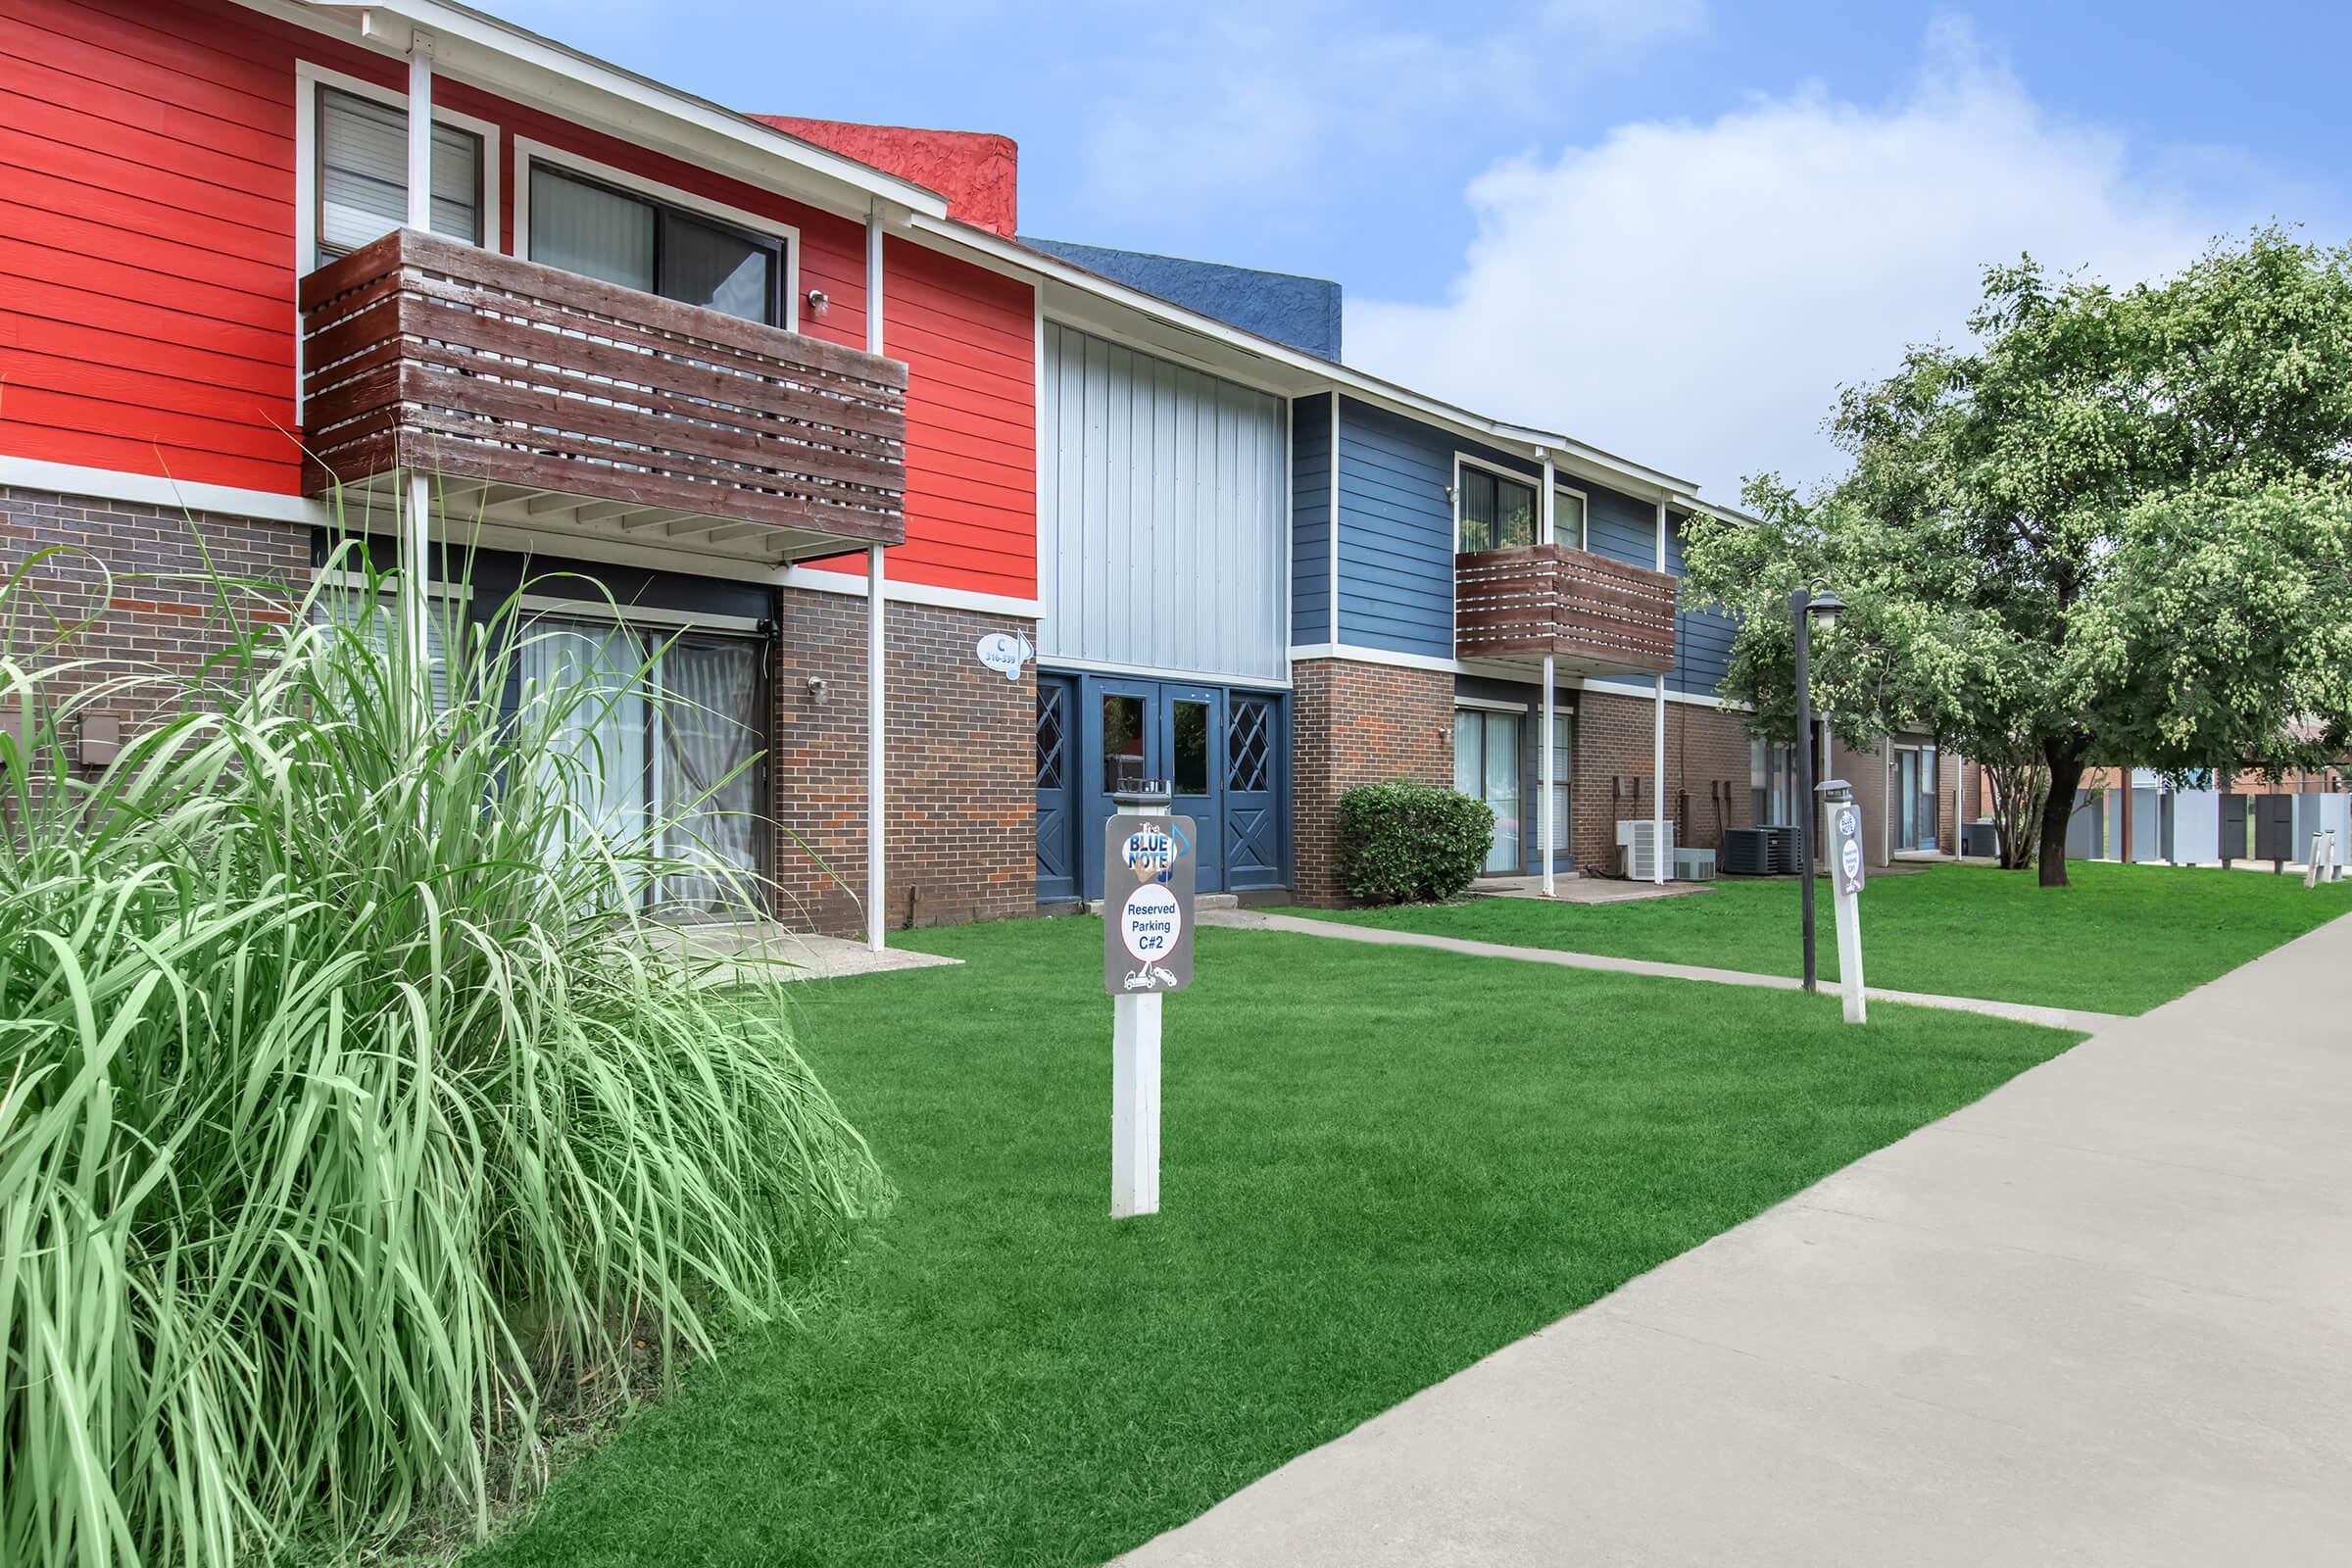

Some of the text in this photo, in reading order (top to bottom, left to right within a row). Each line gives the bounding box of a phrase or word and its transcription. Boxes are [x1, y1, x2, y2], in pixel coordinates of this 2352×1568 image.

[997, 638, 1005, 652] C
[1130, 834, 1167, 852] BLUE
[1128, 903, 1175, 915] Reserved
[1132, 919, 1170, 933] Parking
[1139, 935, 1163, 950] C#2
